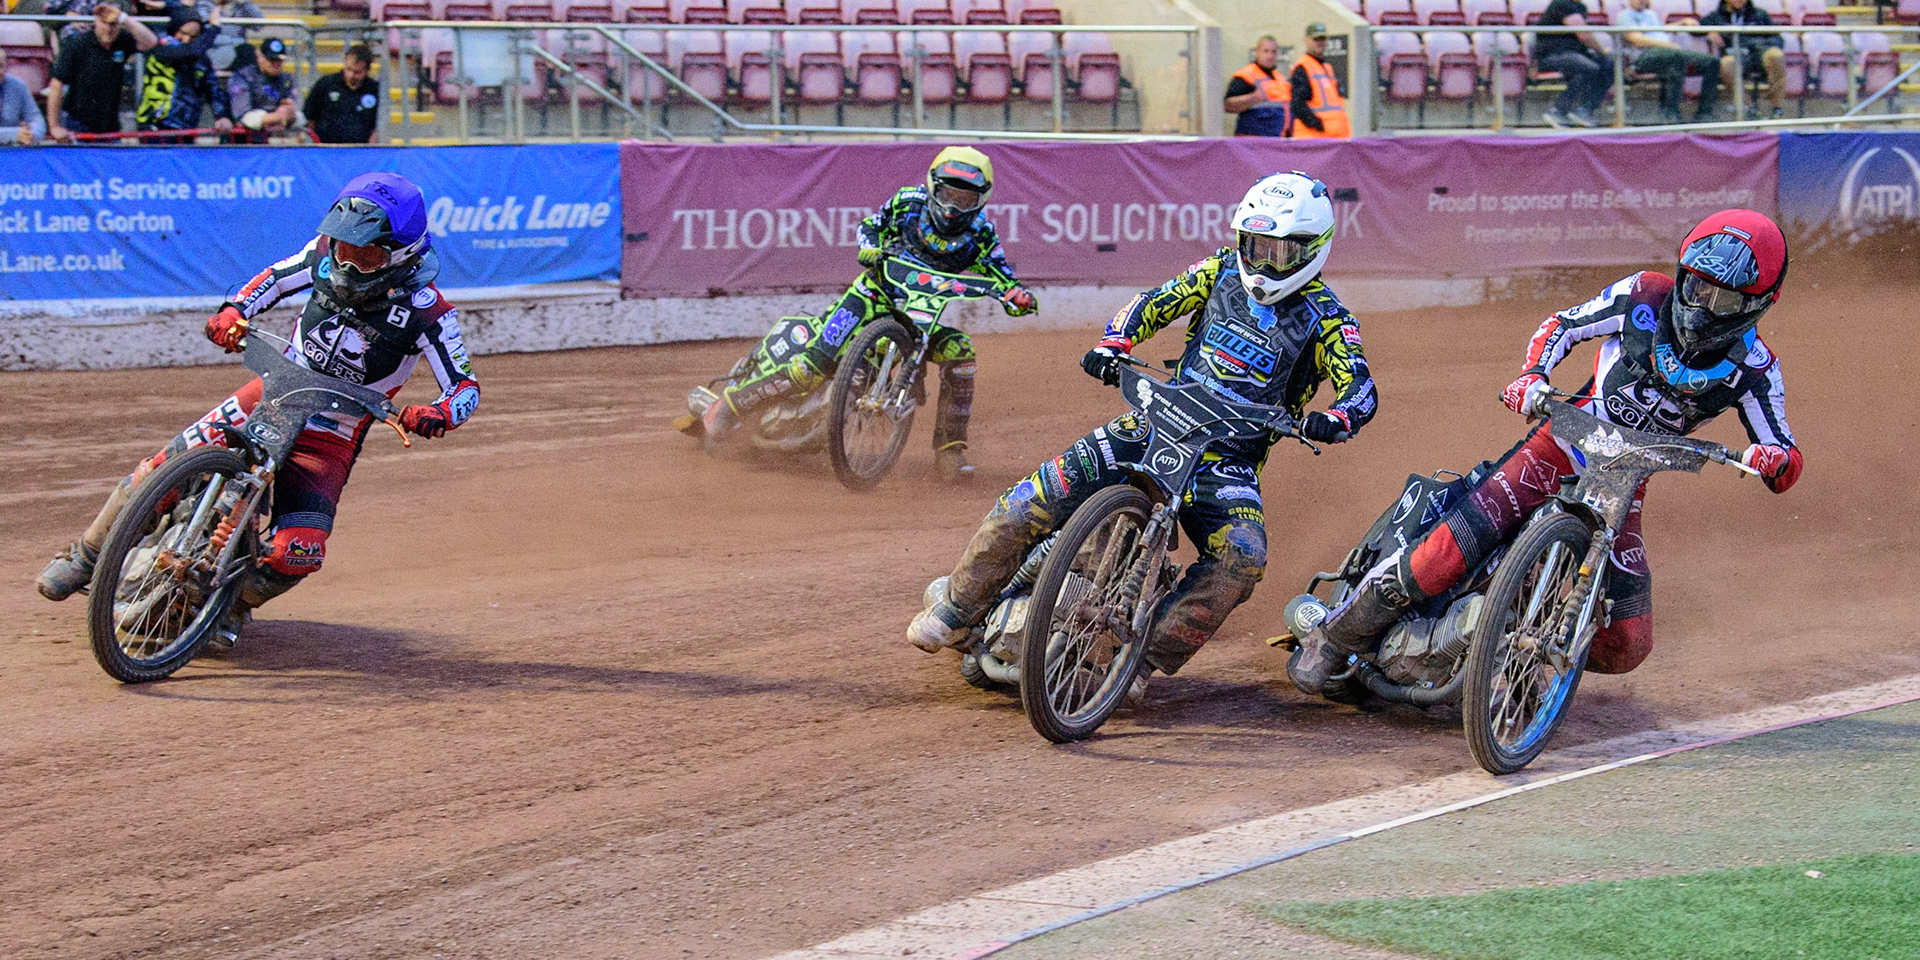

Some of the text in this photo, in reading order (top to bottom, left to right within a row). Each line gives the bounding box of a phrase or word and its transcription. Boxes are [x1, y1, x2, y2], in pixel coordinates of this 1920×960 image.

[0, 176, 295, 205] your next Service and MOT
[1270, 186, 1292, 197] Arai
[1428, 192, 1477, 212] Proud
[1481, 194, 1497, 211] to
[1502, 194, 1567, 214] sponsor
[1571, 190, 1599, 208] the
[1602, 189, 1642, 208] Belle
[1645, 189, 1673, 207] Vue
[1854, 185, 1913, 219] ATPI
[34, 210, 89, 233] Lane
[96, 210, 174, 233] Gorton
[428, 195, 612, 237] Quick Lane
[1206, 326, 1274, 370] BULLETS
[1227, 322, 1266, 346] BERWICK
[1217, 357, 1241, 372] TEAM
[1172, 404, 1213, 437] Henderon
[1499, 479, 1522, 518] SCOTT
